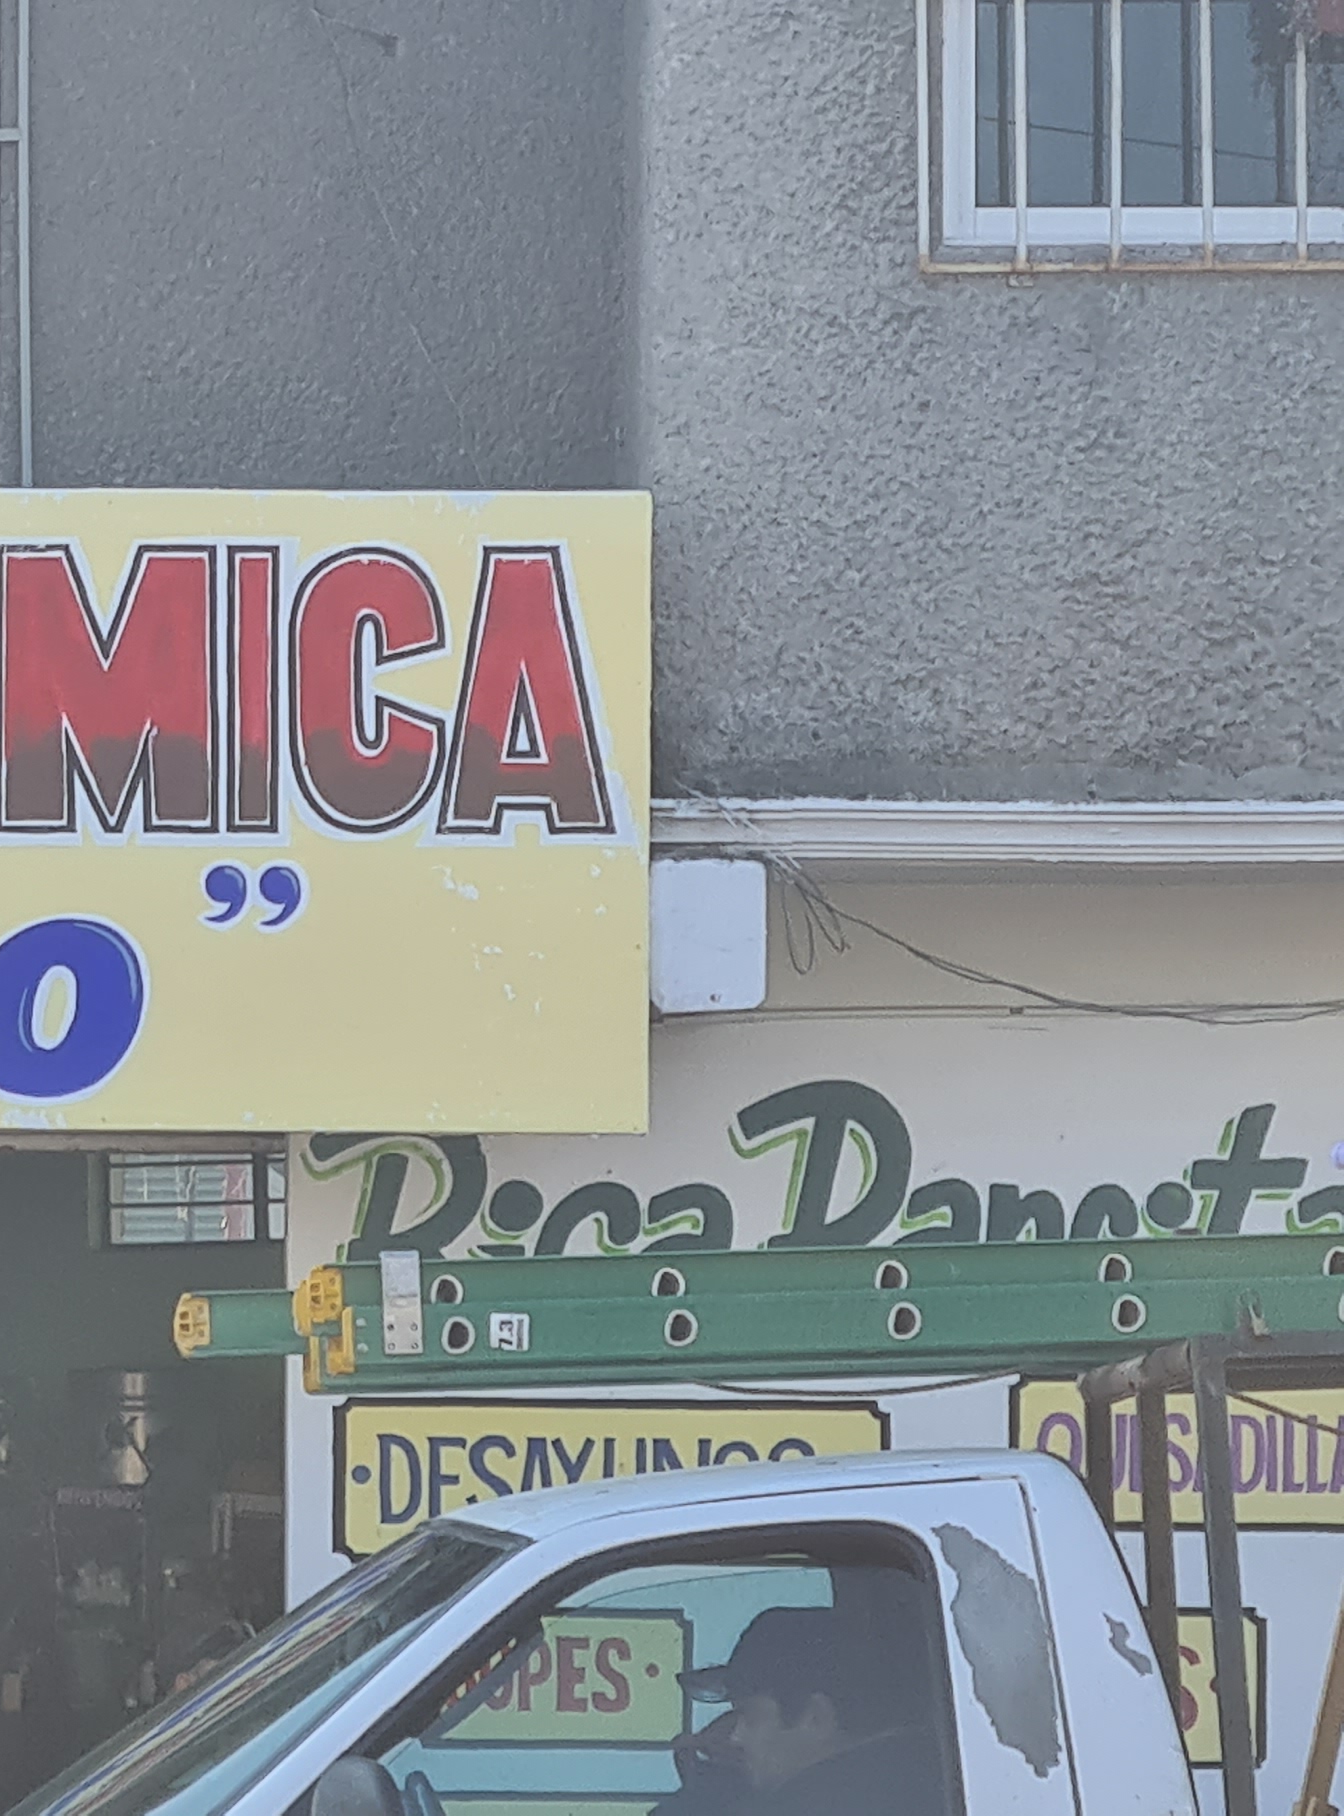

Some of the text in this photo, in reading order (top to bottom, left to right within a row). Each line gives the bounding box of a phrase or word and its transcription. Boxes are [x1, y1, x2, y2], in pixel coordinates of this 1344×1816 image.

[376, 1432, 816, 1525] DESAY
[1036, 1411, 1344, 1494] QSDILL
[482, 1636, 633, 1713] PES
